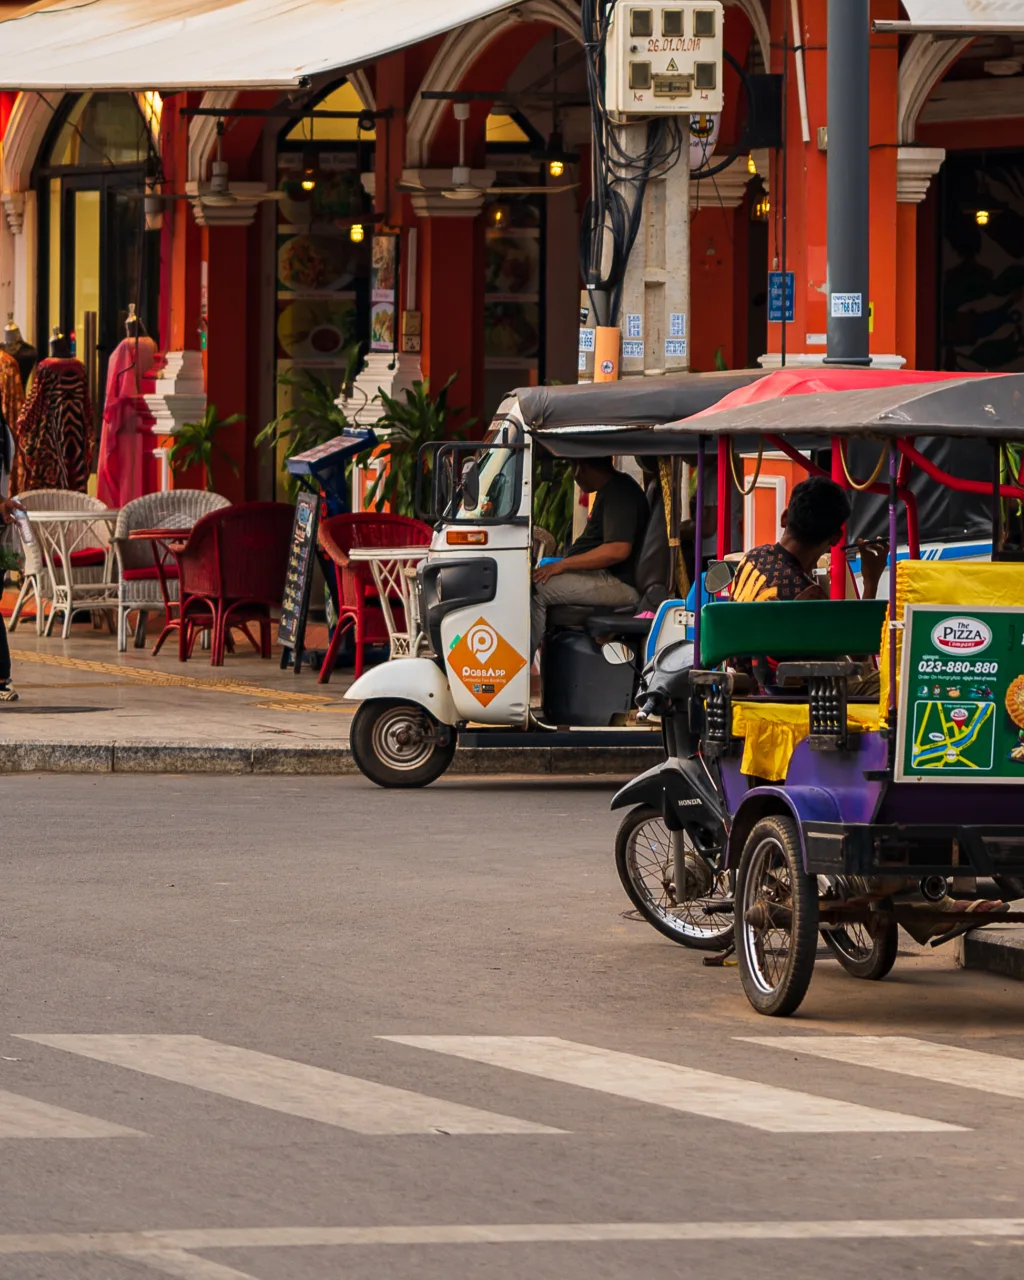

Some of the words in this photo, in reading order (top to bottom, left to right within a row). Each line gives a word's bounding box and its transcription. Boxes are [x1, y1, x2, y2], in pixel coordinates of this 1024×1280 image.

[943, 626, 982, 640] PIZZA
[948, 640, 975, 648] Company
[918, 660, 998, 674] 023-880-880
[677, 798, 703, 806] HONDA
